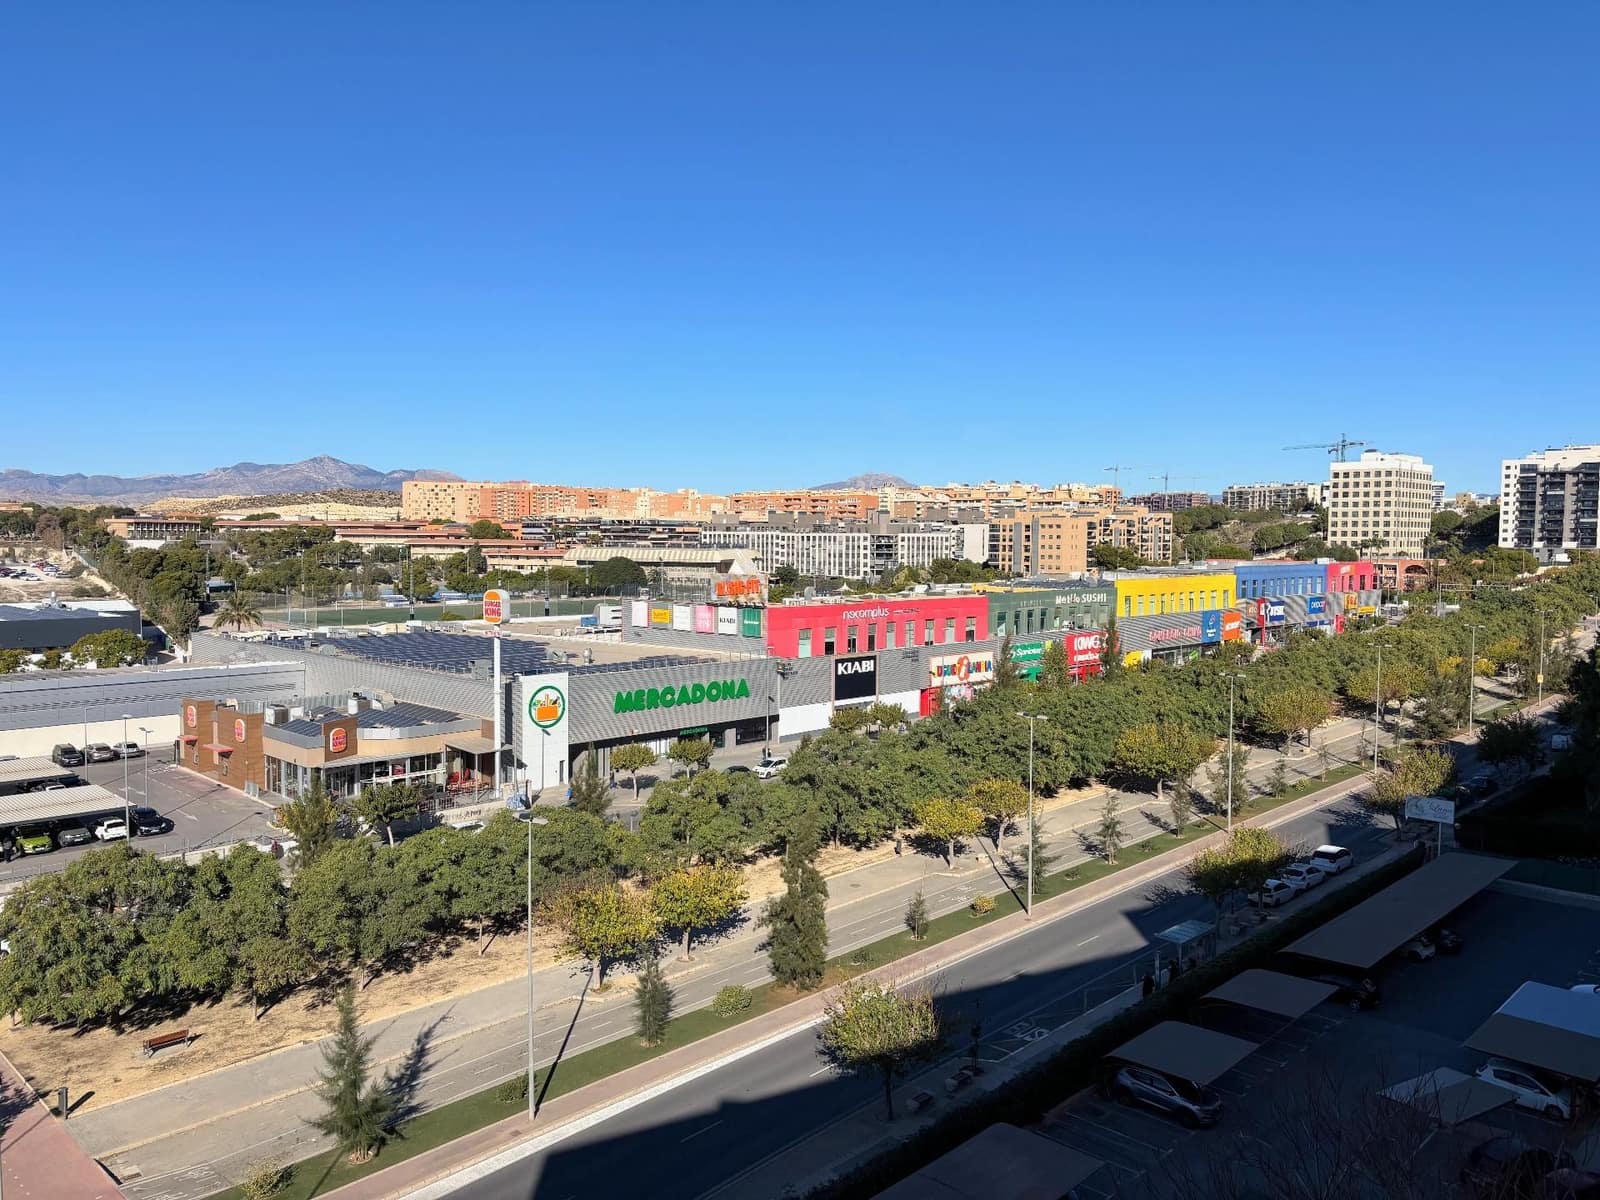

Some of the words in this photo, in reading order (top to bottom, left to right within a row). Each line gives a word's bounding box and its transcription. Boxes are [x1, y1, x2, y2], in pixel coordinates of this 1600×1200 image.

[1081, 592, 1107, 603] SUSHI
[485, 607, 501, 617] KING
[837, 659, 875, 676] KIABI
[613, 678, 750, 714] MERCADONA
